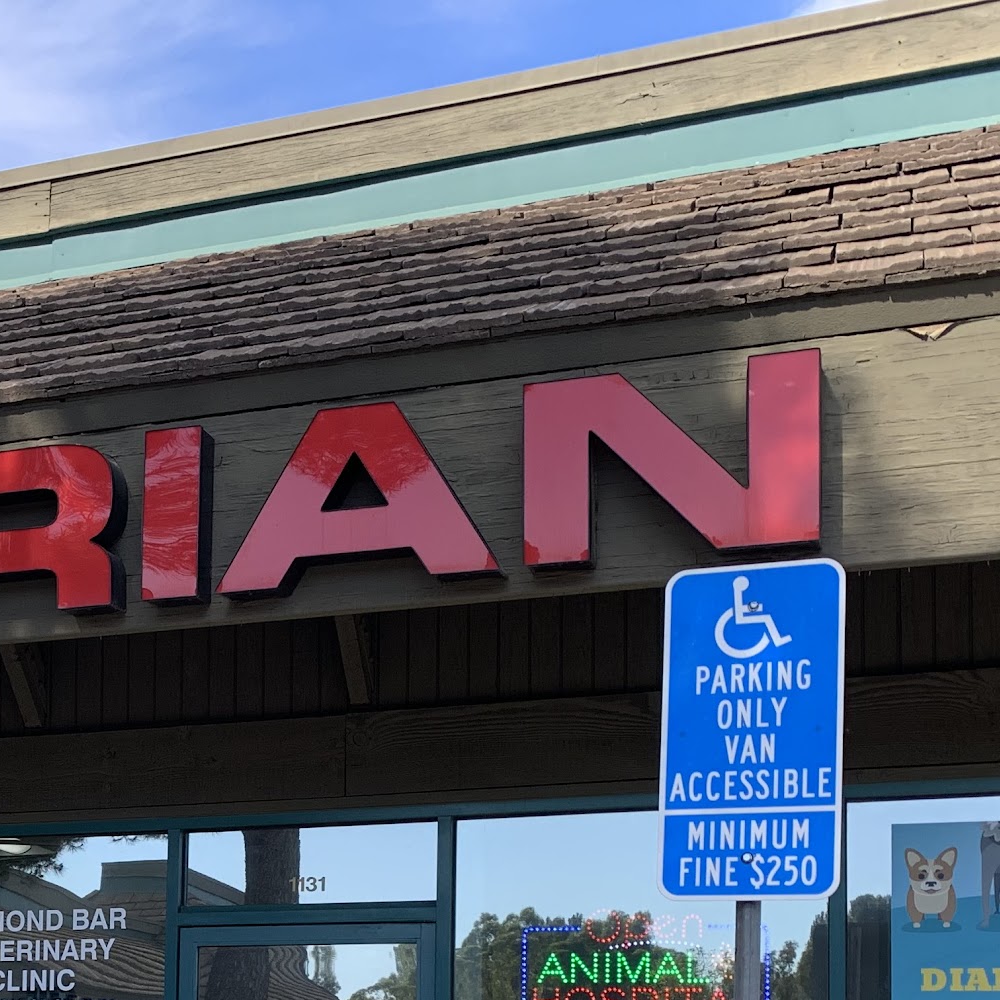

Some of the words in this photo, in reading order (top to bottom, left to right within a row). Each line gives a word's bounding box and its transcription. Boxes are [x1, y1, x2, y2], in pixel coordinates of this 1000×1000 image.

[695, 659, 811, 695] PARKING
[717, 697, 788, 730] ONLY
[724, 733, 775, 764] VAN
[669, 767, 832, 802] ACCESSIBLE
[687, 818, 810, 851] MINIMUM
[289, 876, 326, 892] 1131
[679, 857, 739, 887] FINE
[750, 853, 817, 890] $250
[72, 907, 127, 930] BAR
[537, 951, 710, 984] ANIMAL
